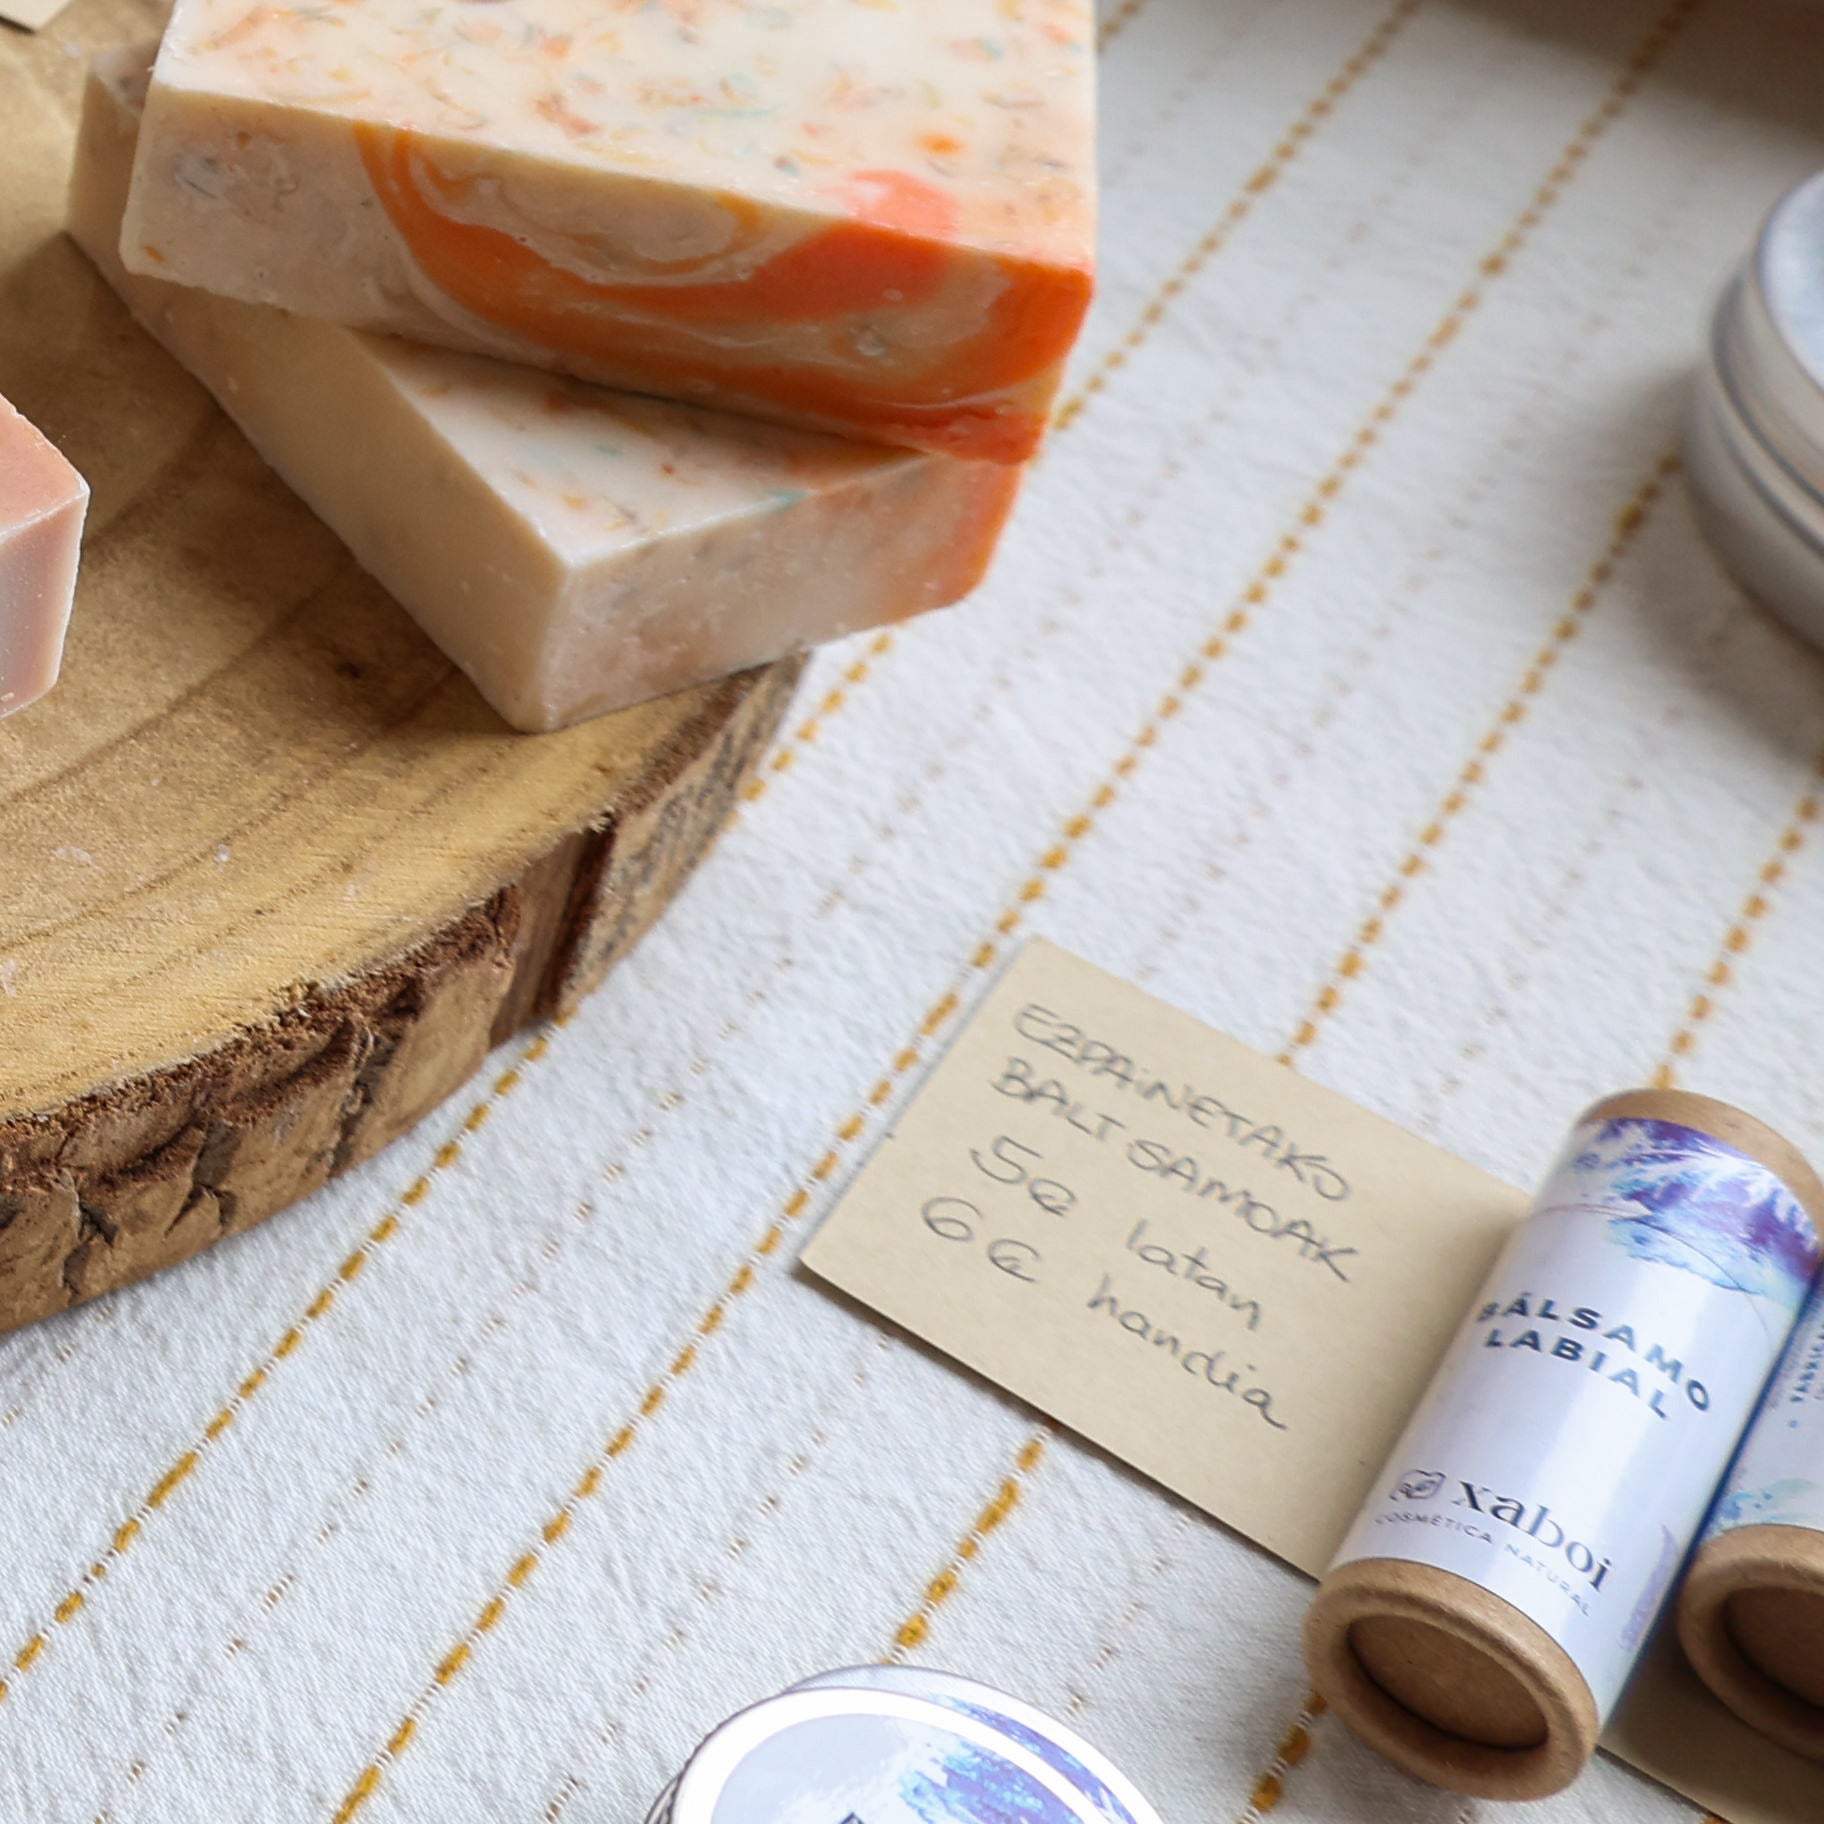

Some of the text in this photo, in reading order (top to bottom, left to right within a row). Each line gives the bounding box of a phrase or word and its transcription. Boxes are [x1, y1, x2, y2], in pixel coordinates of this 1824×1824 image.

[1126, 1218, 1261, 1331] latan
[1086, 1272, 1288, 1431] handia
[1477, 1290, 1710, 1412] BÁLSAMO
[1484, 1328, 1668, 1420] LABIAL
[1451, 1479, 1612, 1593] xaboi
[1504, 1543, 1590, 1617] NATURAL
